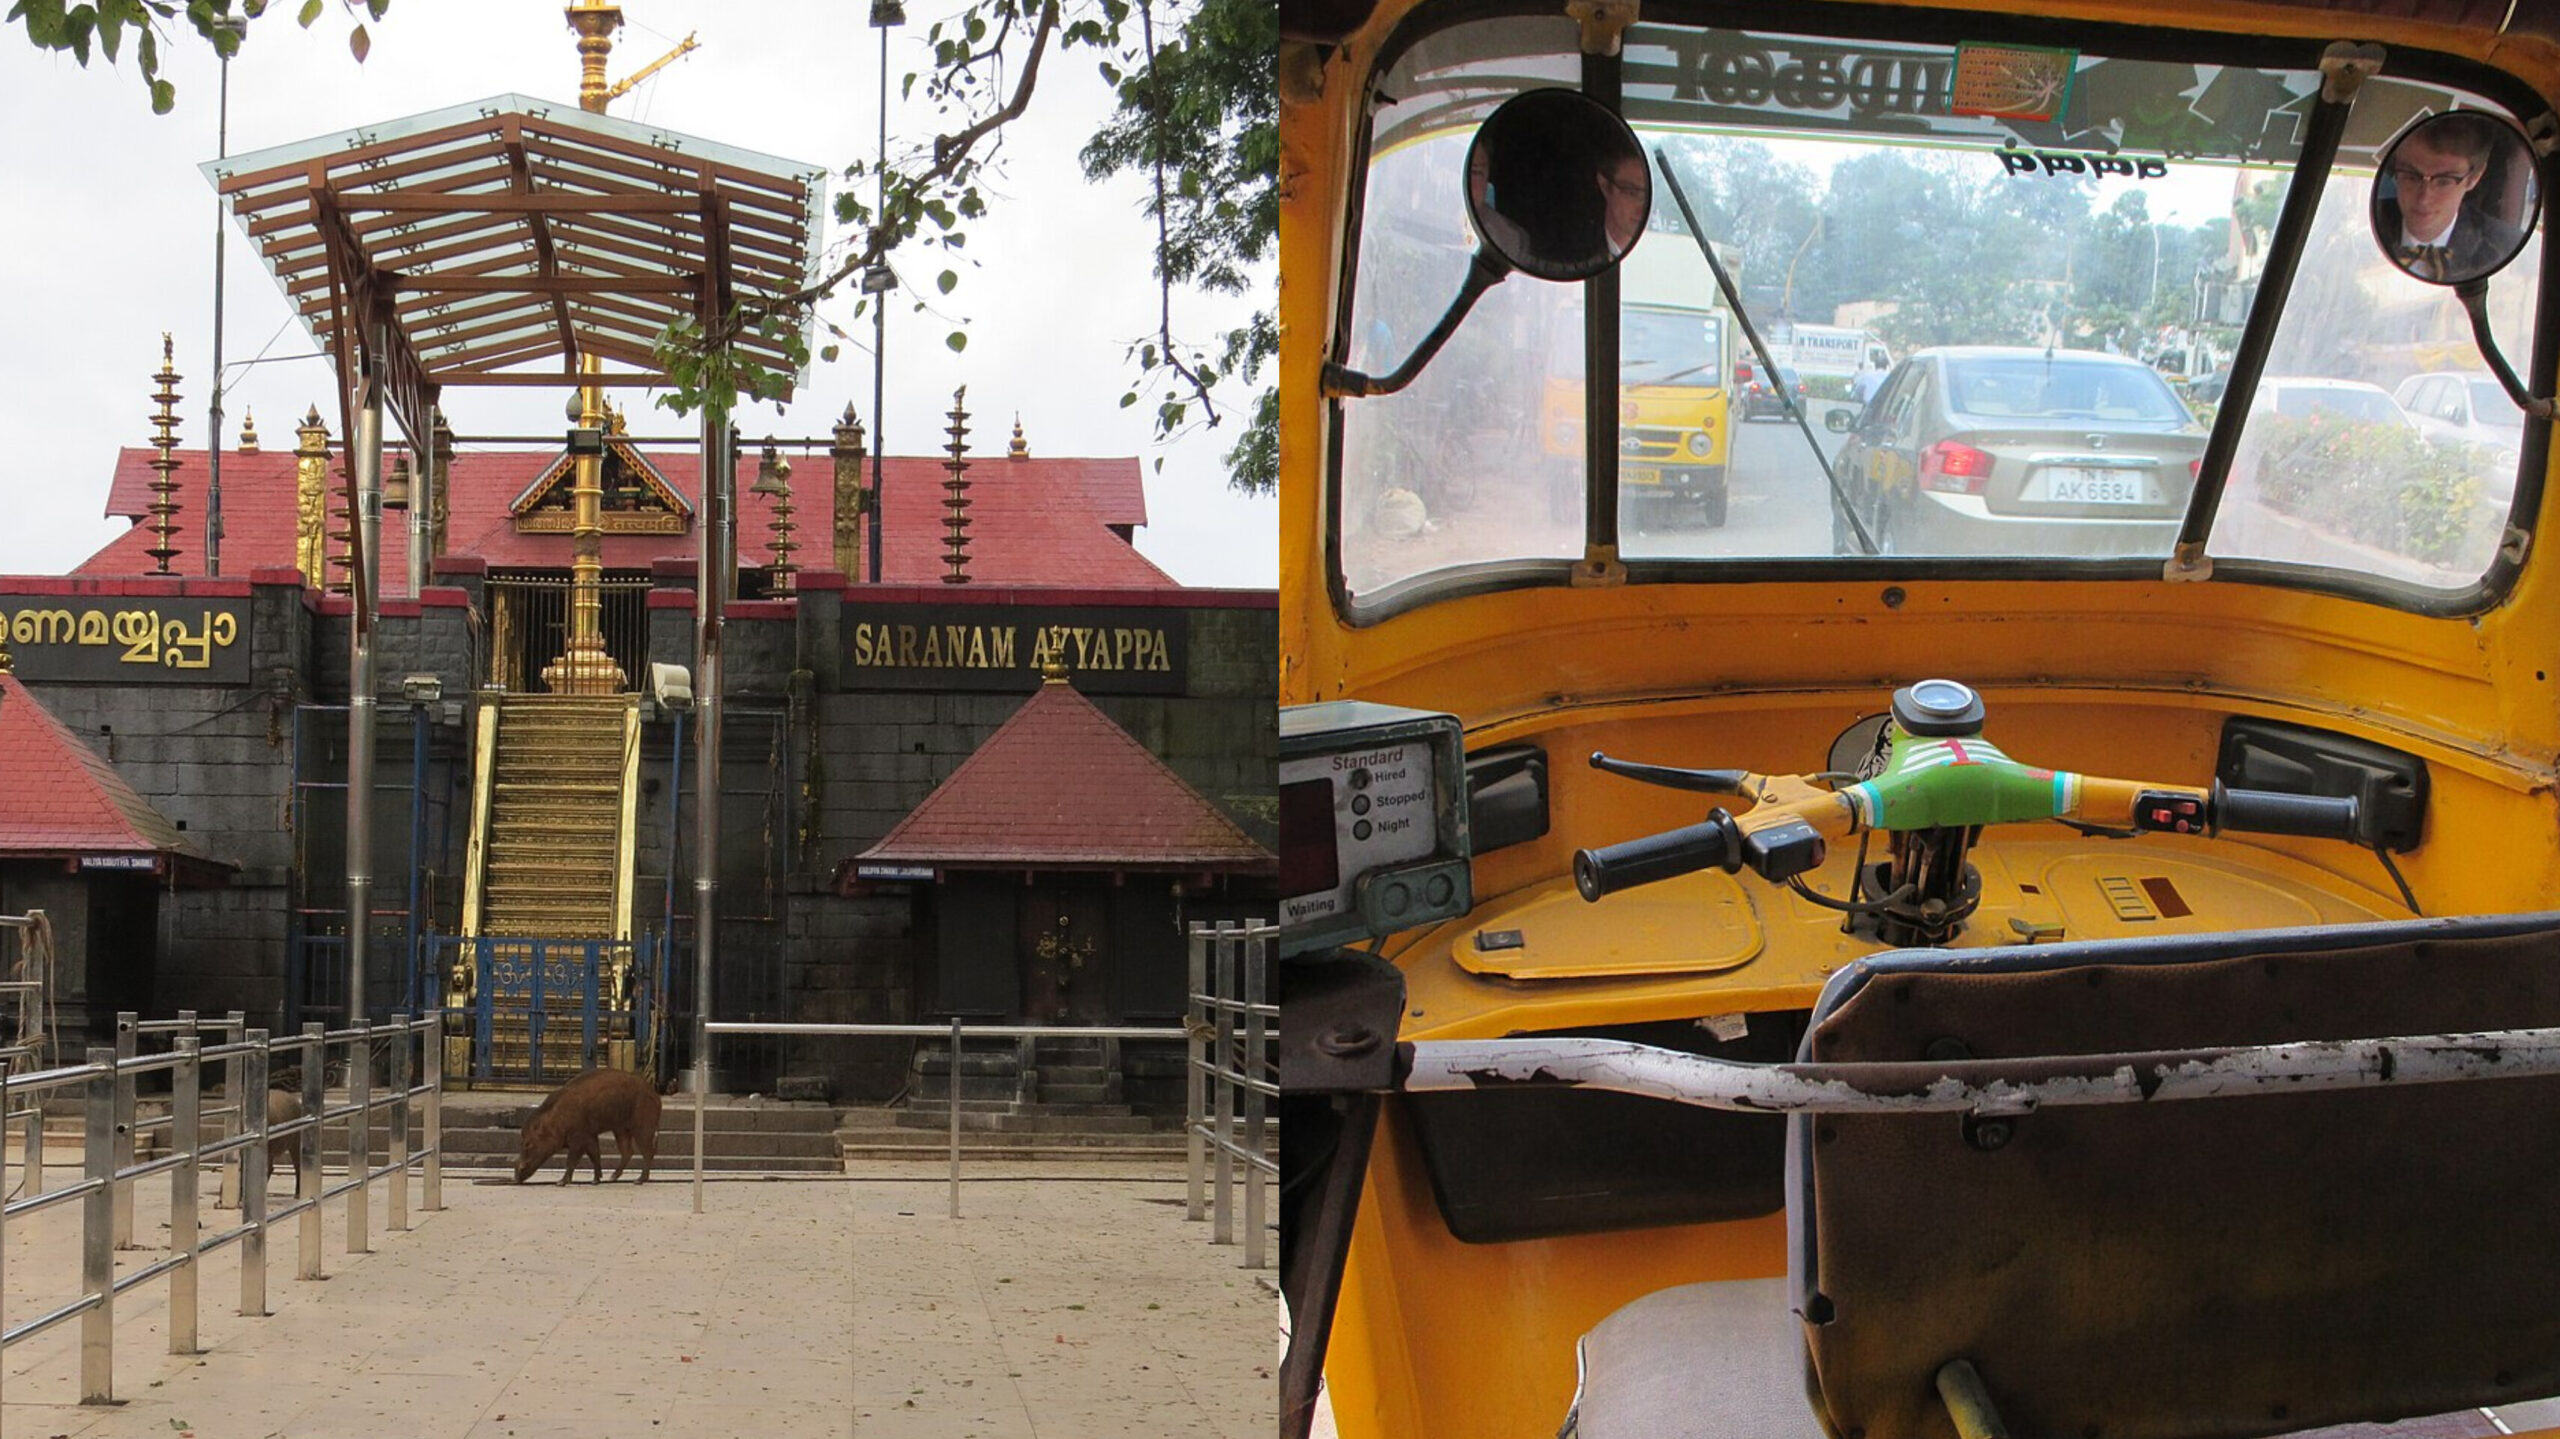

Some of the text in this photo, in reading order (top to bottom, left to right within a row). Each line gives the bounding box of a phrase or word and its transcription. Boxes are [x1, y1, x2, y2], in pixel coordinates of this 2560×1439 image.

[0, 609, 237, 668] ണമയ്യപ്പാ
[855, 623, 1171, 671] SARANAM AYYAPPA
[1332, 748, 1404, 771] Standard
[1375, 768, 1406, 782] Hired
[1377, 789, 1425, 807] Stopped
[1378, 818, 1410, 833] Night
[1287, 899, 1335, 917] Waiting
